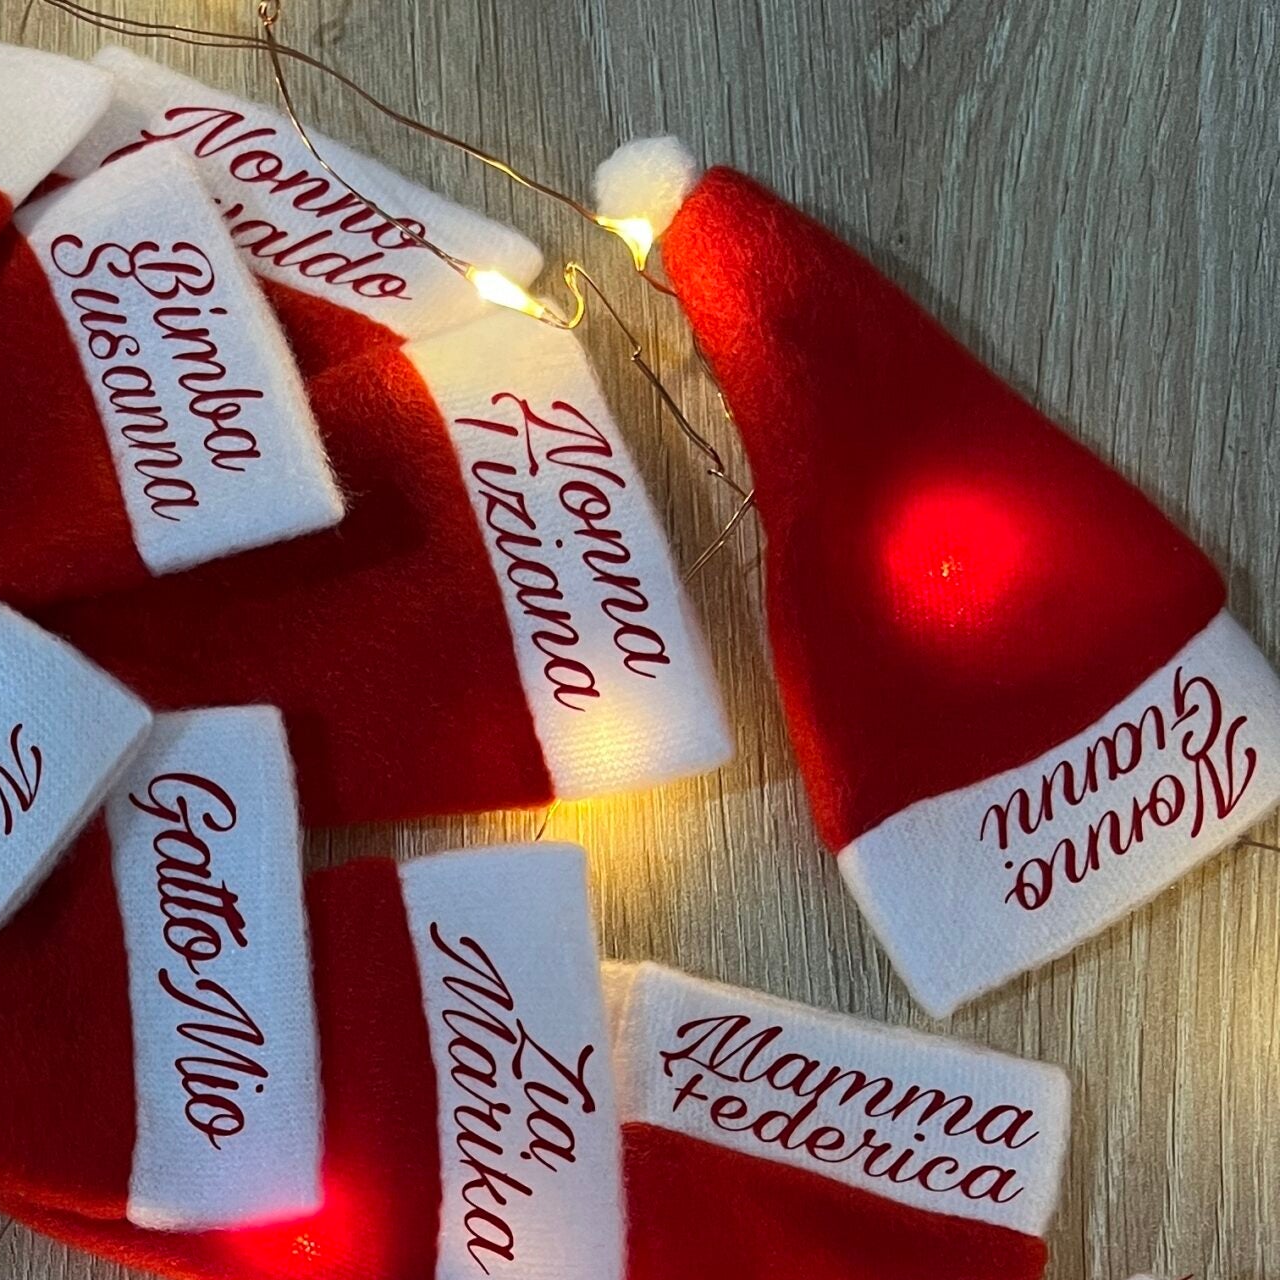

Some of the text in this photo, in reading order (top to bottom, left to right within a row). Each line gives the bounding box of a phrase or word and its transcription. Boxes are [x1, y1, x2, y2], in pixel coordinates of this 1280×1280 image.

[142, 106, 426, 250] Nonno
[50, 233, 200, 522] Susanna
[126, 241, 263, 473] Bimba
[455, 393, 600, 712] Tiziana
[521, 398, 671, 680] Nonna
[980, 666, 1222, 870] Gianni
[1005, 716, 1257, 911] Nonno
[128, 771, 270, 1152] Gatto Mio
[430, 921, 533, 1276] Marika
[513, 1018, 596, 1173] Zia
[659, 1045, 1024, 1205] Federica
[673, 1014, 1040, 1151] Mamma
